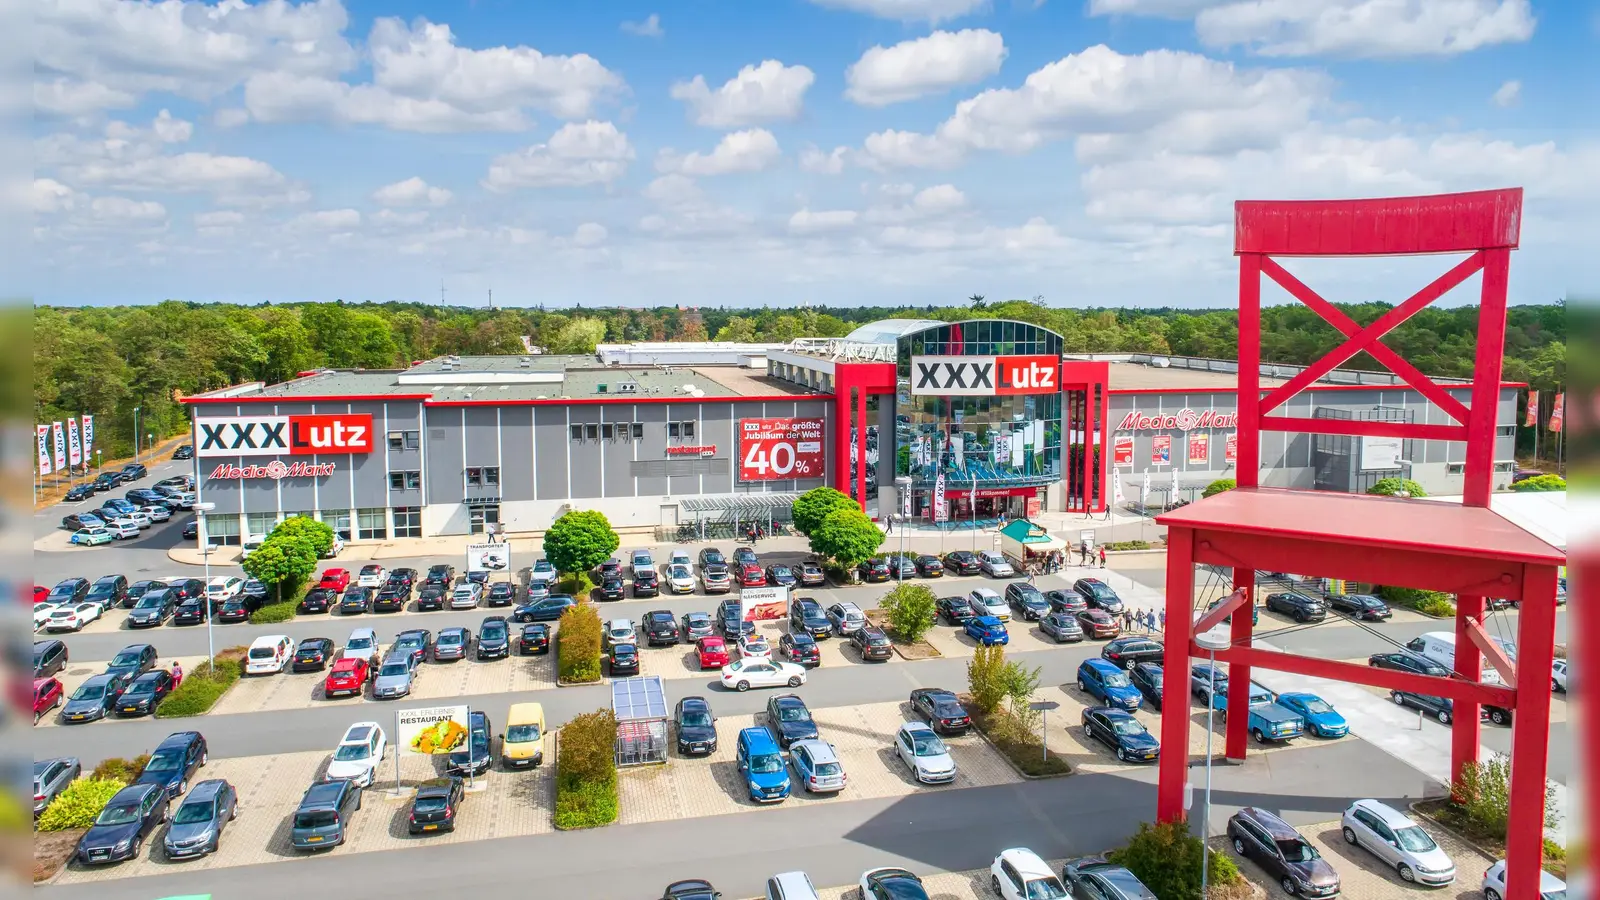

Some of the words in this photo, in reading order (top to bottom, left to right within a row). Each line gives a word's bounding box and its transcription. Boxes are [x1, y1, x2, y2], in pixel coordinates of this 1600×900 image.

[916, 362, 1054, 389] XXXLutz
[775, 421, 789, 430] Das
[792, 421, 821, 431] größte
[1115, 411, 1177, 431] Media
[200, 420, 367, 450] XXXLutz
[745, 431, 784, 440] Jubiläum
[786, 431, 800, 439] der
[801, 430, 821, 438] Welt
[208, 463, 269, 479] Media
[283, 461, 336, 478] Markt
[400, 714, 453, 724] RESTAURANT
